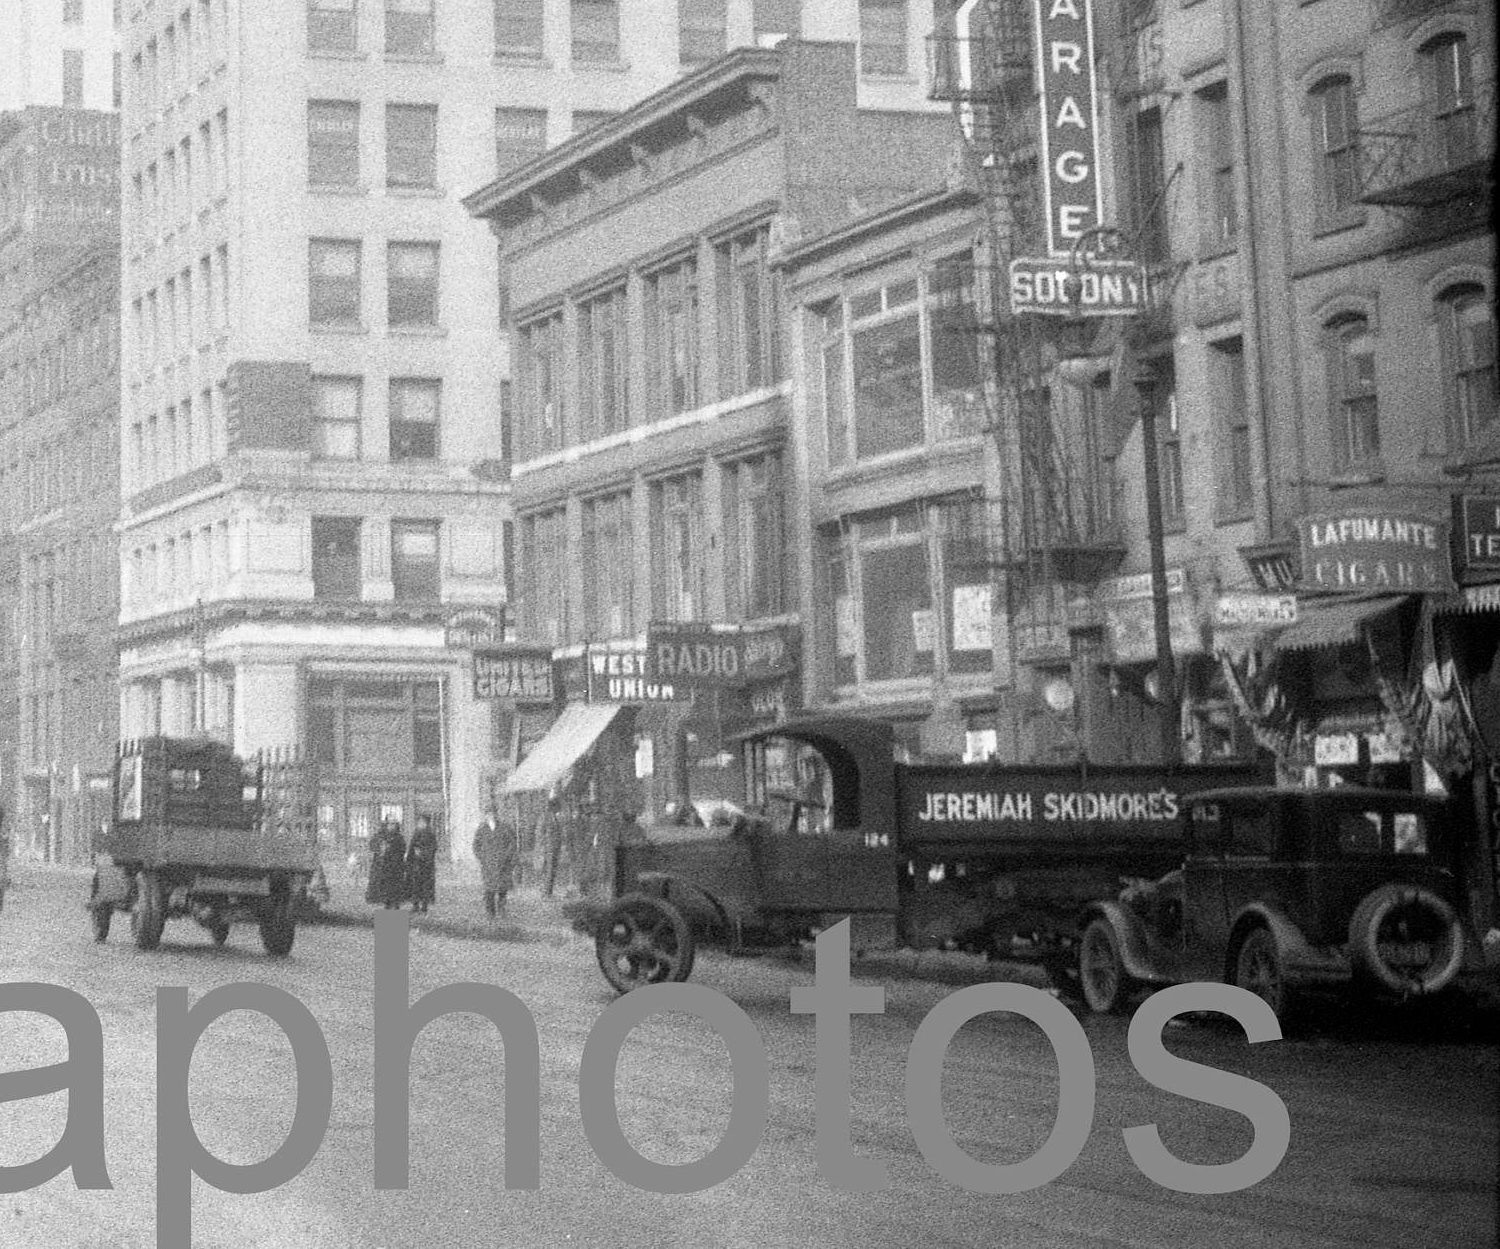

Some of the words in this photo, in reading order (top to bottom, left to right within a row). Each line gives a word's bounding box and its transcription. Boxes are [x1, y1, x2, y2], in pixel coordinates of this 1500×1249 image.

[1310, 518, 1437, 549] LAFUMANTE
[1314, 560, 1436, 586] CIGARS
[657, 643, 738, 677] RADIO
[918, 794, 1031, 822] JEREMIAH
[1043, 790, 1179, 821] SKIDMORE'S
